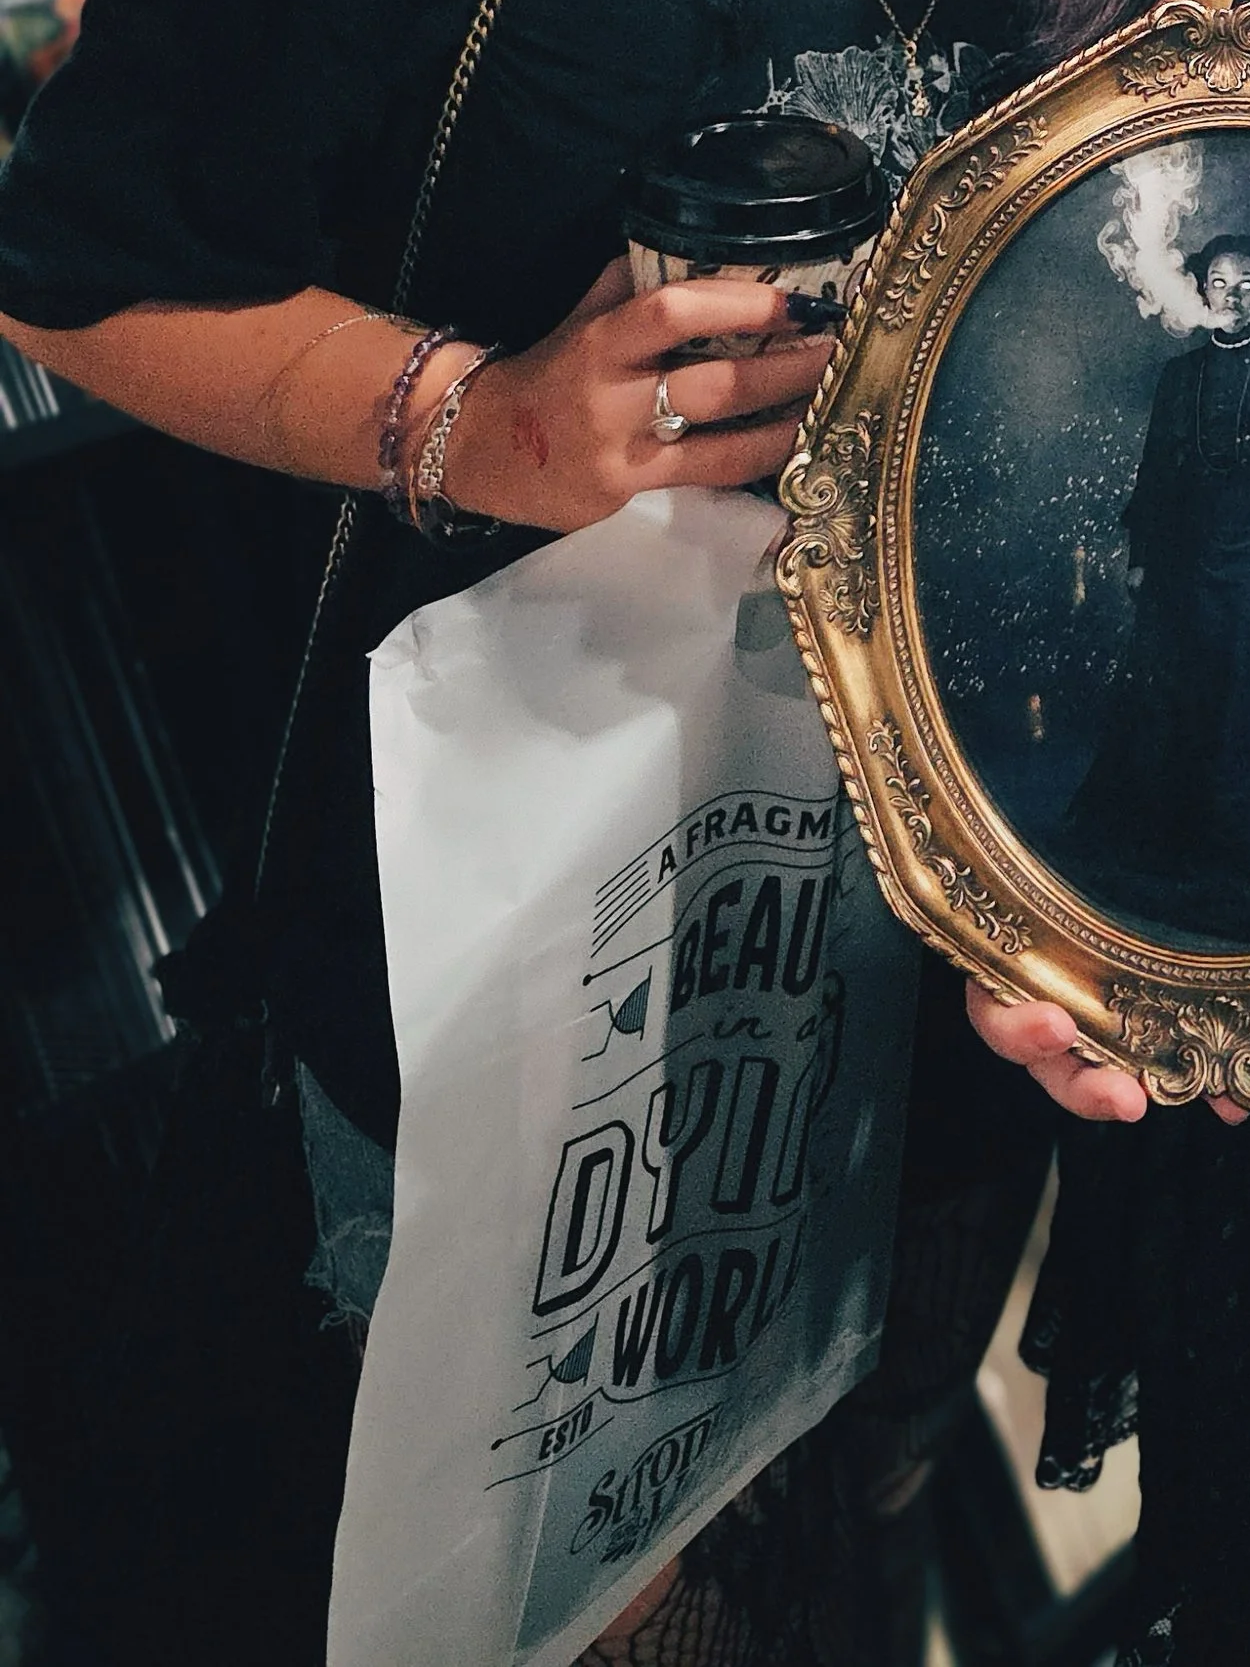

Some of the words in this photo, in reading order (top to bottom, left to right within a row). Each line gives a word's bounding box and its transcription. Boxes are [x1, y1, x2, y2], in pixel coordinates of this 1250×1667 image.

[657, 844, 678, 884] A
[685, 801, 832, 860] FRAGM
[538, 1400, 594, 1462] ESTD
